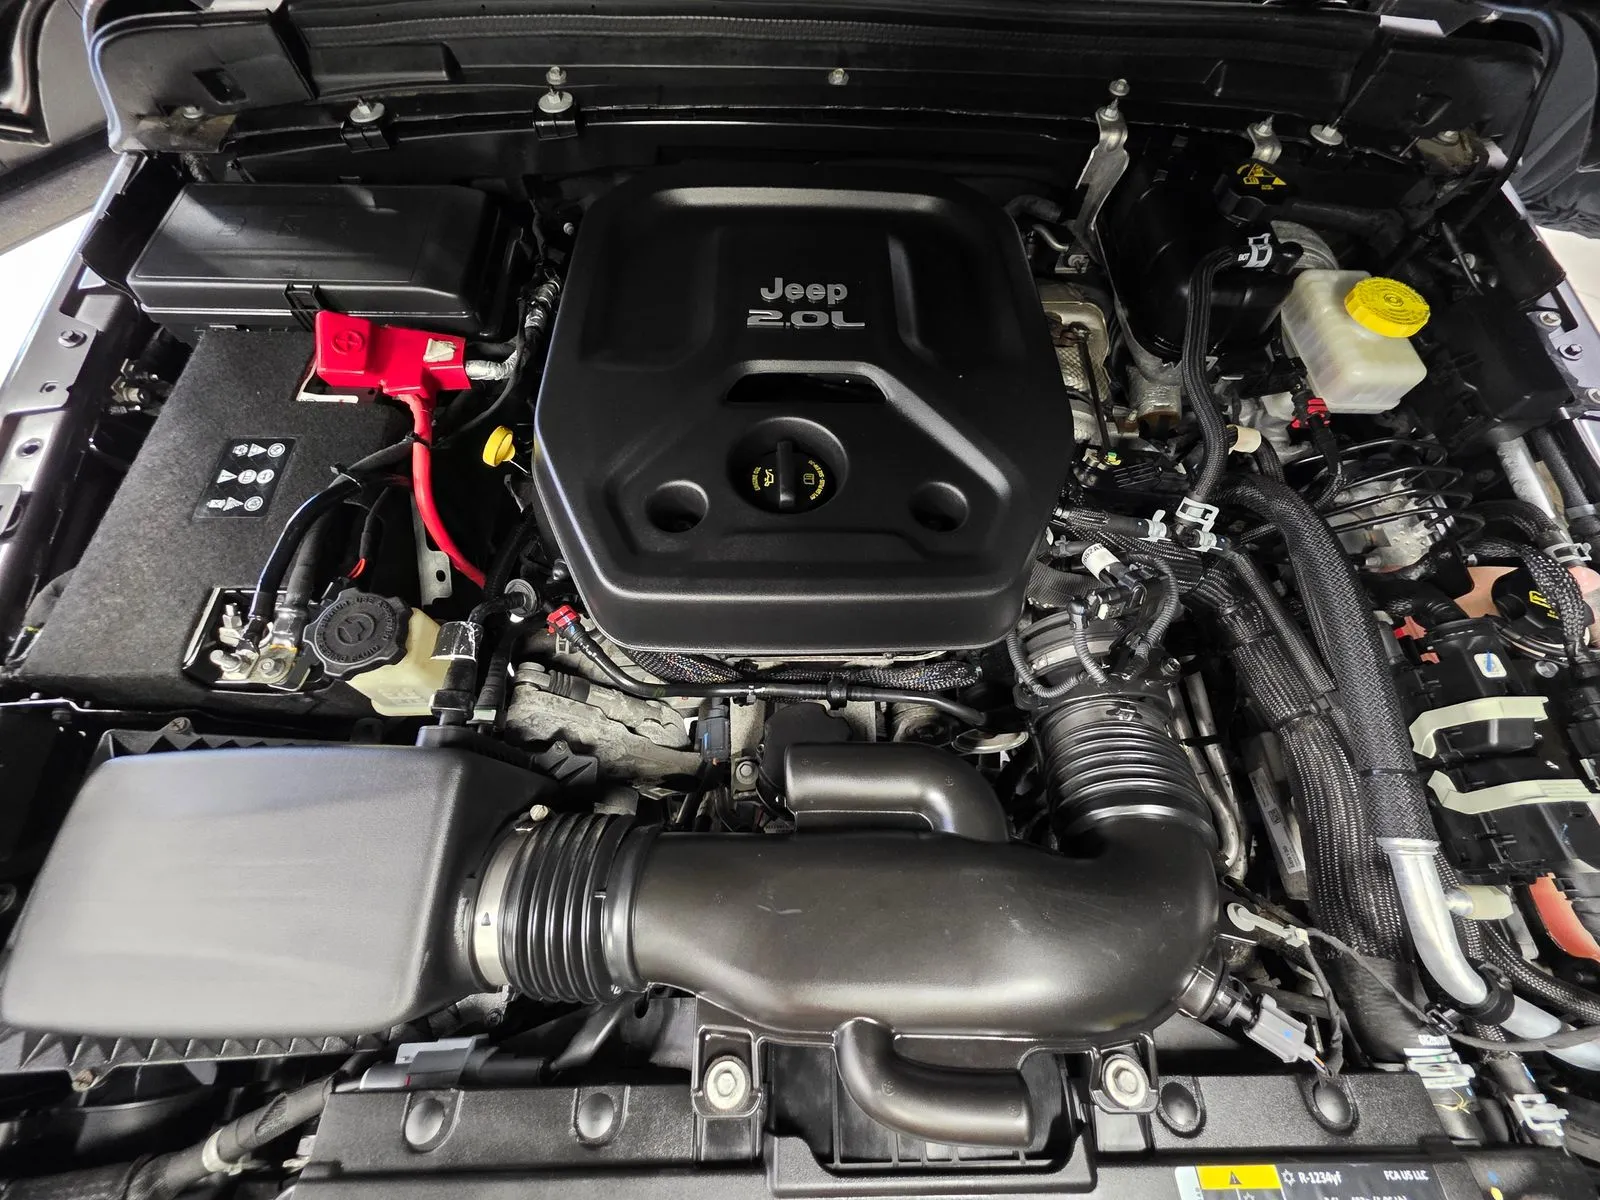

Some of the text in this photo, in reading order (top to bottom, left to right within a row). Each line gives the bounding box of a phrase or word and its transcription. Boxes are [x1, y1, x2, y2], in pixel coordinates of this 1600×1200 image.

[760, 277, 848, 305] Jeep
[747, 309, 865, 328] 2.0L
[1297, 1170, 1429, 1186] R-1234yf FCA US LLC
